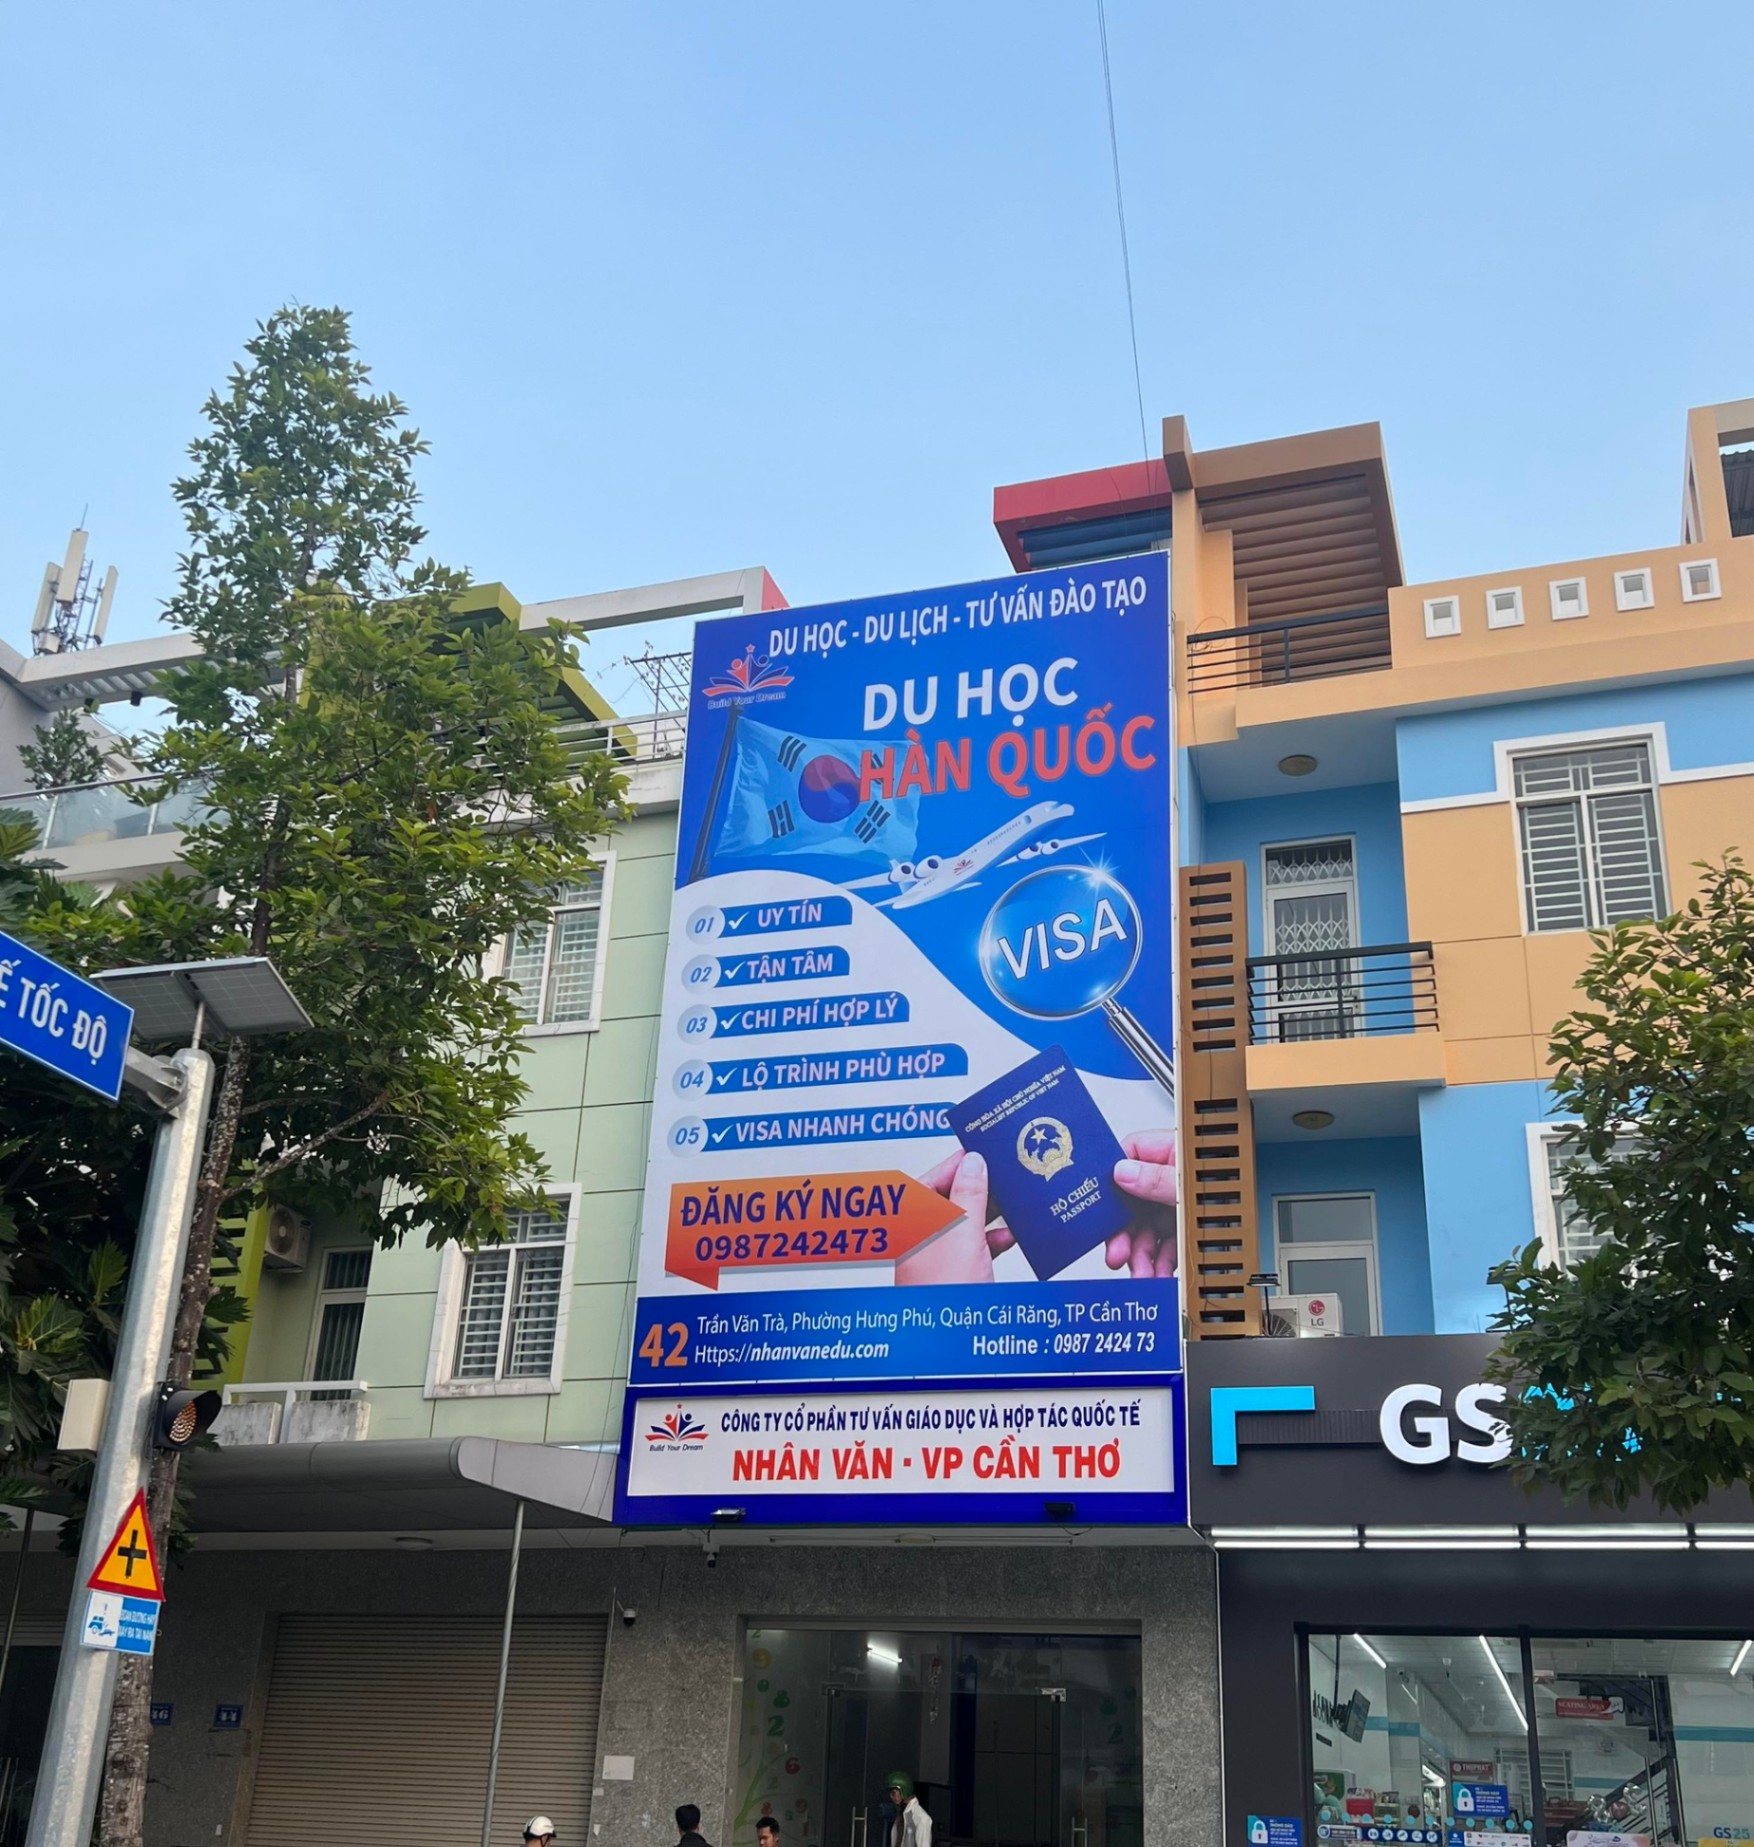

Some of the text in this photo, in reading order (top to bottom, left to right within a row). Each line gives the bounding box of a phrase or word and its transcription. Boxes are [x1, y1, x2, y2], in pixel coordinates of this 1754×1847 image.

[769, 628, 798, 658] DU
[803, 620, 847, 660] HỌC
[864, 614, 894, 644] DU
[900, 608, 947, 646] LỊCH
[966, 591, 997, 628] TƯ
[1000, 584, 1044, 624] VẤN
[1049, 577, 1097, 618] ĐÀO
[1101, 574, 1146, 616] TẠO
[863, 656, 1078, 731] DU HỌC
[859, 702, 1156, 802] HÀN QUỐC
[694, 899, 822, 934] 01 UY TÍN
[998, 898, 1128, 980] VISA
[690, 950, 834, 984] 02 TẬN TÂM
[18, 976, 68, 1038] TỐC
[71, 1010, 107, 1066] ĐỘ
[686, 992, 898, 1034] 03 CHI PHÍ HỢP LÝ
[680, 1050, 945, 1091] 04 LỘ TRÌNH PHÙ HỢP
[675, 1105, 950, 1146] 05 VISA NHANH CHÓNG
[680, 1178, 907, 1226] ĐĂNG KÝ NGAY
[1050, 1176, 1100, 1216] HỘ CHIẾU
[1060, 1190, 1102, 1224] PASSPORT
[696, 1228, 888, 1262] 0987242473
[698, 1300, 1158, 1334] Trần Văn Trà, Phường Hưng Phú, Quận Cái Răng, TP Cần Thơ
[1311, 1318, 1324, 1326] LG
[638, 1322, 688, 1367] 42
[694, 1340, 890, 1367] Https://nhanvanedu.com
[972, 1334, 1038, 1356] Hotline
[1054, 1333, 1091, 1354] 0987
[1094, 1332, 1132, 1354] 2424
[1136, 1332, 1155, 1352] 73
[721, 1398, 1142, 1434] CÔNG TY CỔ PHẦN TƯ VẤN GIÁO DỤC VÀ HỢP TÁC QUỐC TẾ
[732, 1441, 820, 1481] NHÂN
[832, 1440, 892, 1480] VĂN
[922, 1446, 964, 1479] VP
[972, 1434, 1040, 1479] CẦN
[1052, 1437, 1120, 1478] THƠ
[768, 1715, 784, 1736] 2
[1714, 1826, 1750, 1840] GS25
